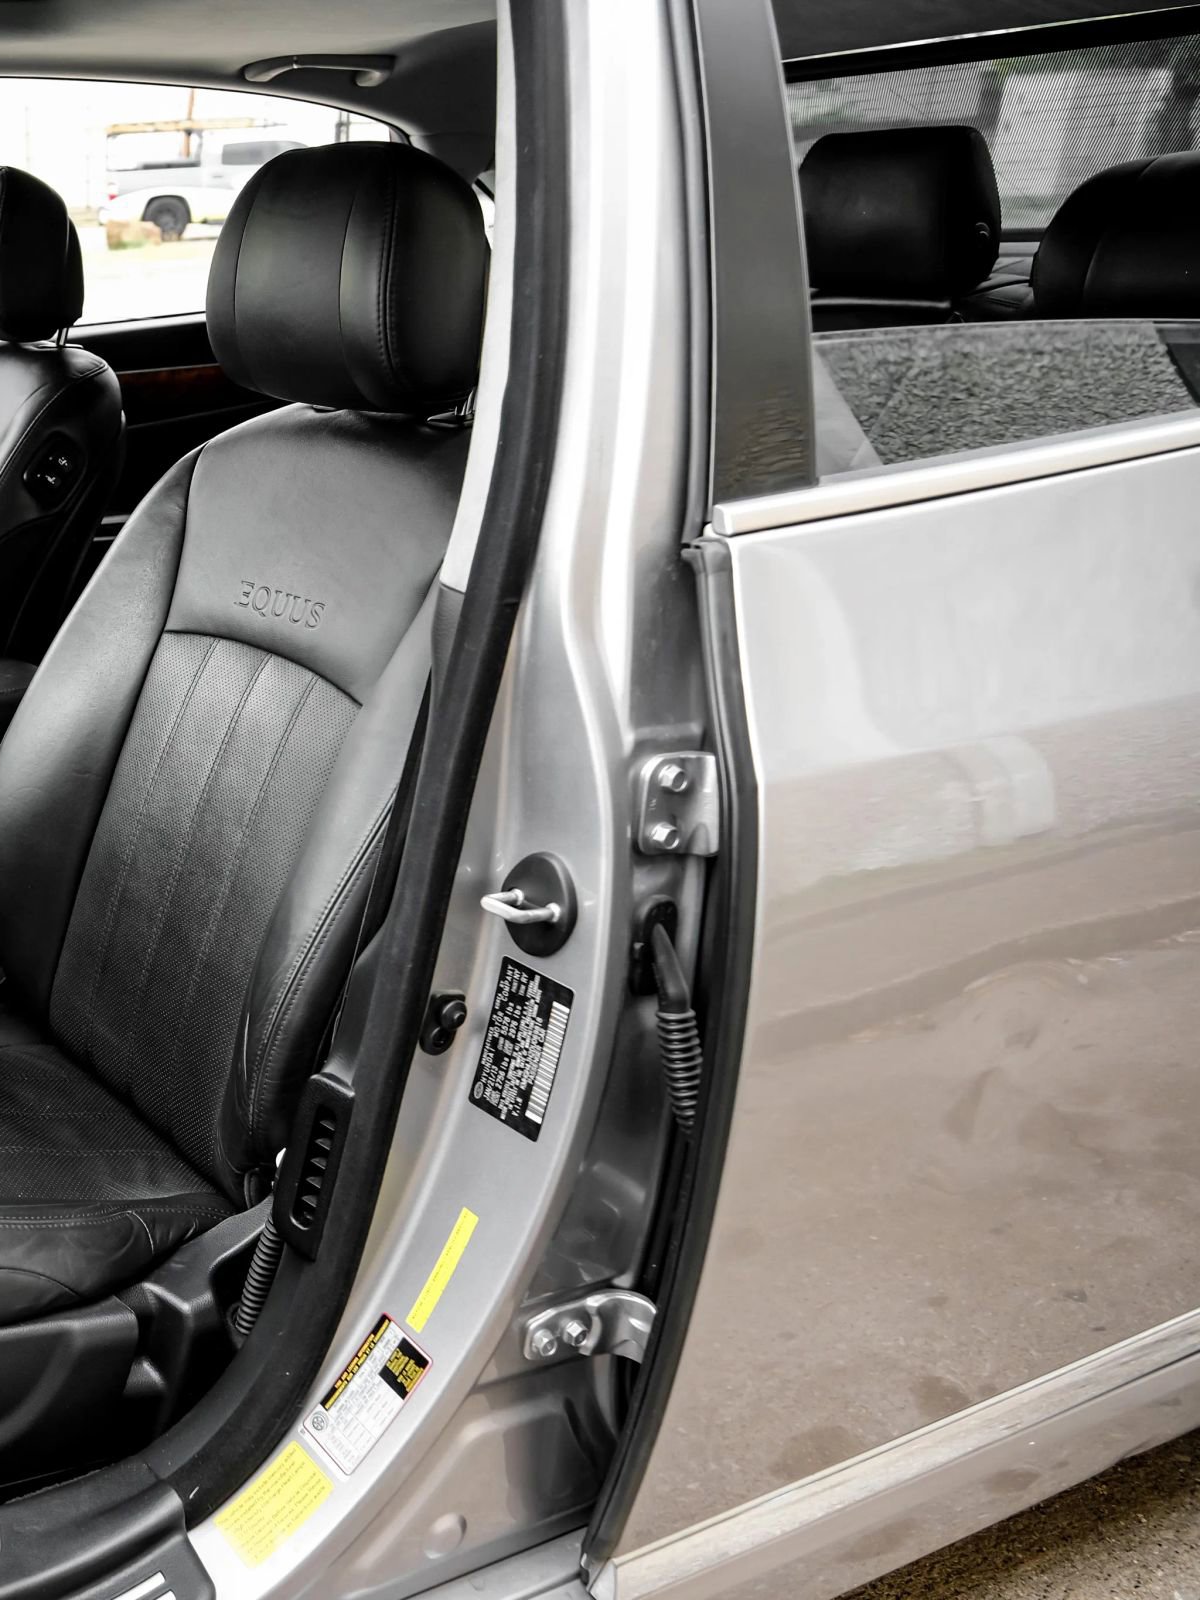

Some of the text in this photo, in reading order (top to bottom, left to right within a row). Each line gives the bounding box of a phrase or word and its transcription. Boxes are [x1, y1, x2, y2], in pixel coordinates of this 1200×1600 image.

[234, 580, 326, 629] EQUUS
[480, 1047, 495, 1083] HYUNDAI
[493, 1011, 504, 1038] MOTOR
[502, 964, 514, 1002] COMPANY
